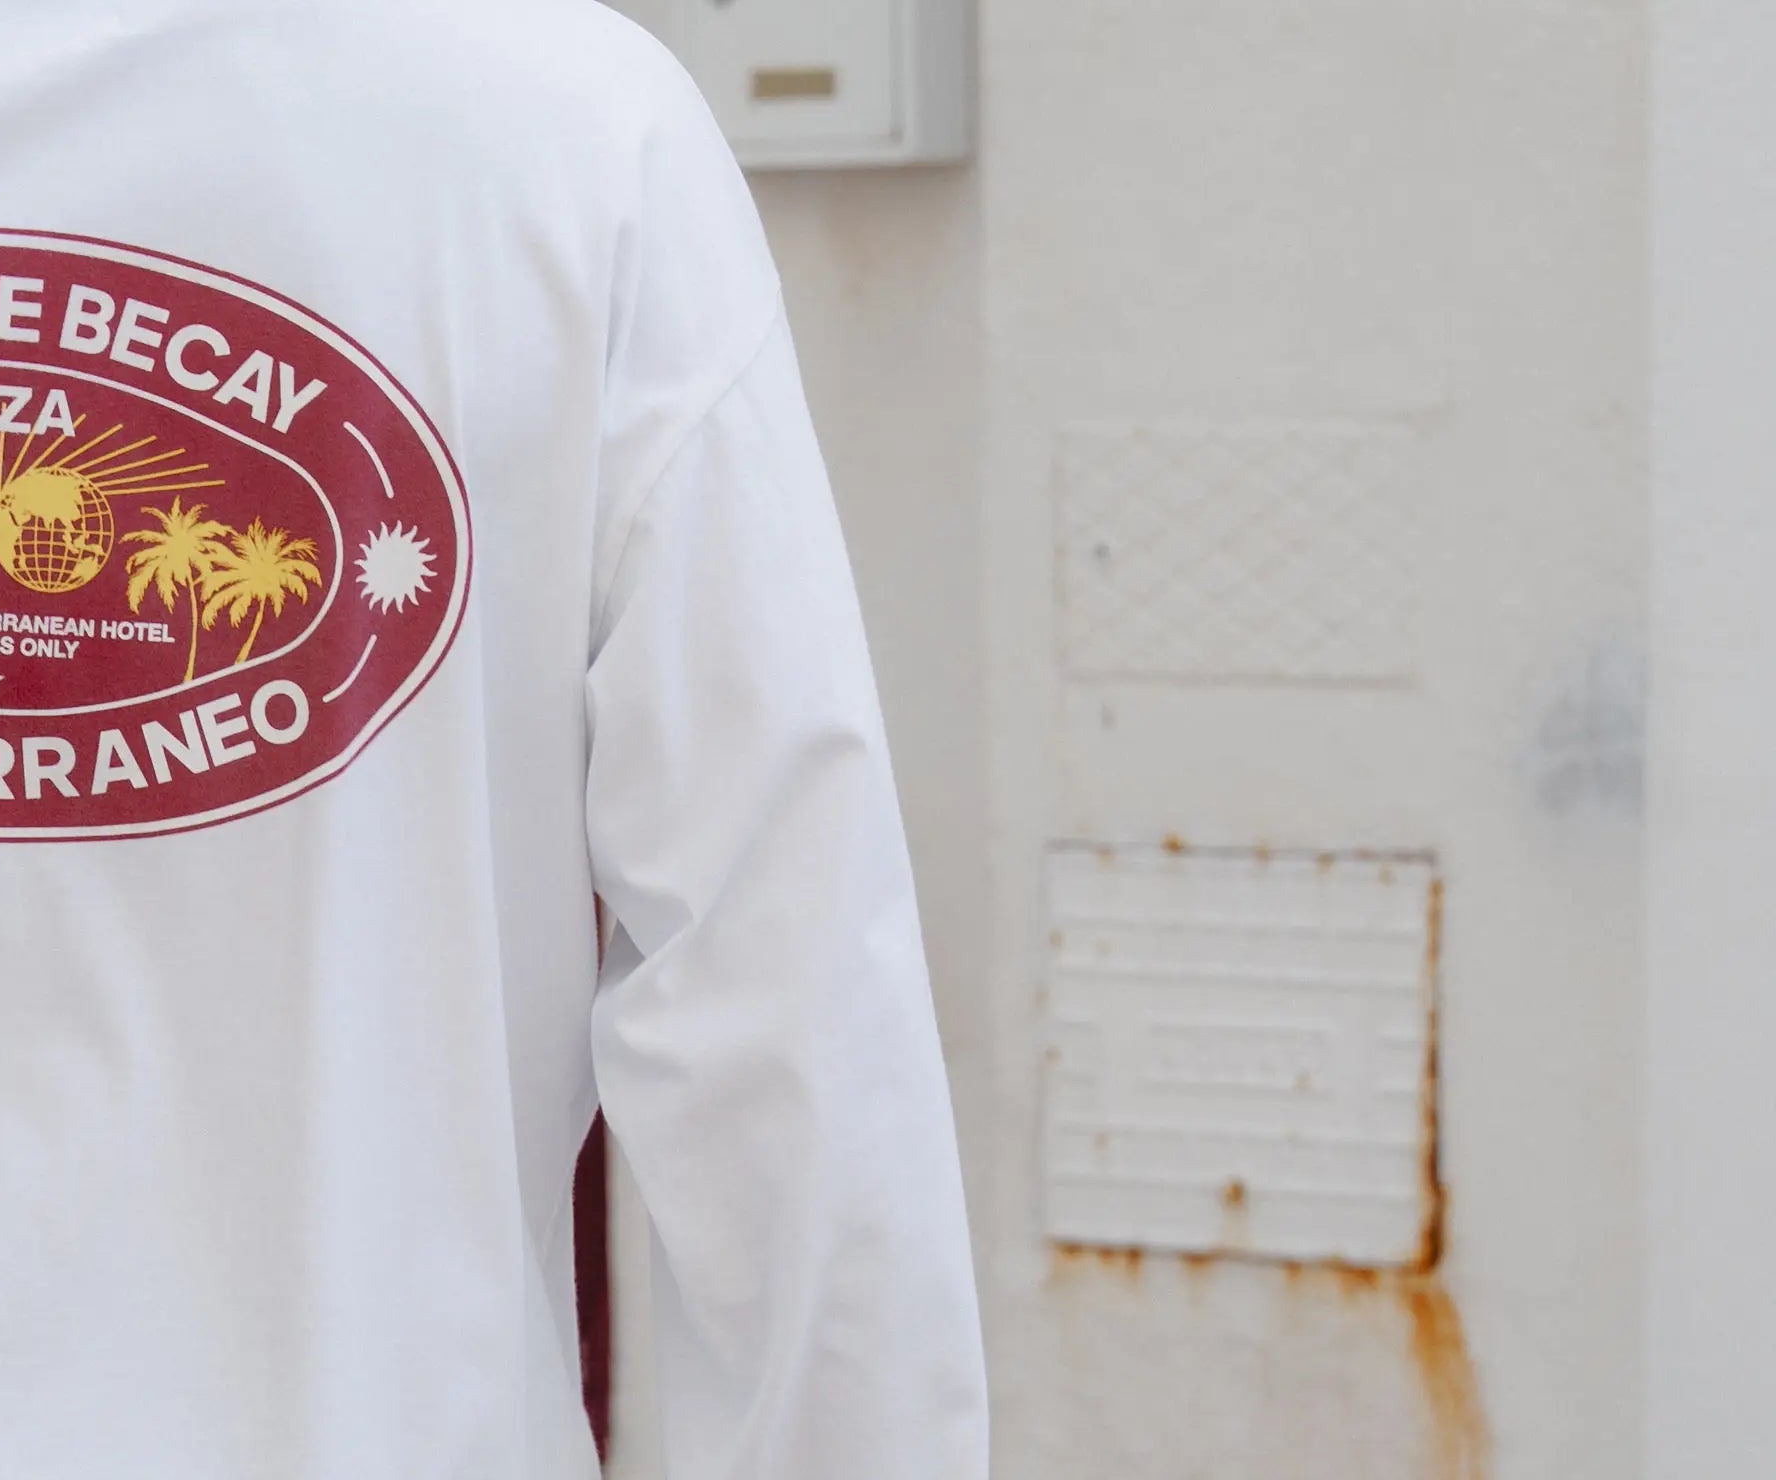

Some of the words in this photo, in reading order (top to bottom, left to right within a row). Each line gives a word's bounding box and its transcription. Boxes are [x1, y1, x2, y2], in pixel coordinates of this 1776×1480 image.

[58, 283, 328, 434] BECAY
[100, 619, 176, 643] HOTEL
[19, 637, 81, 659] ONLY
